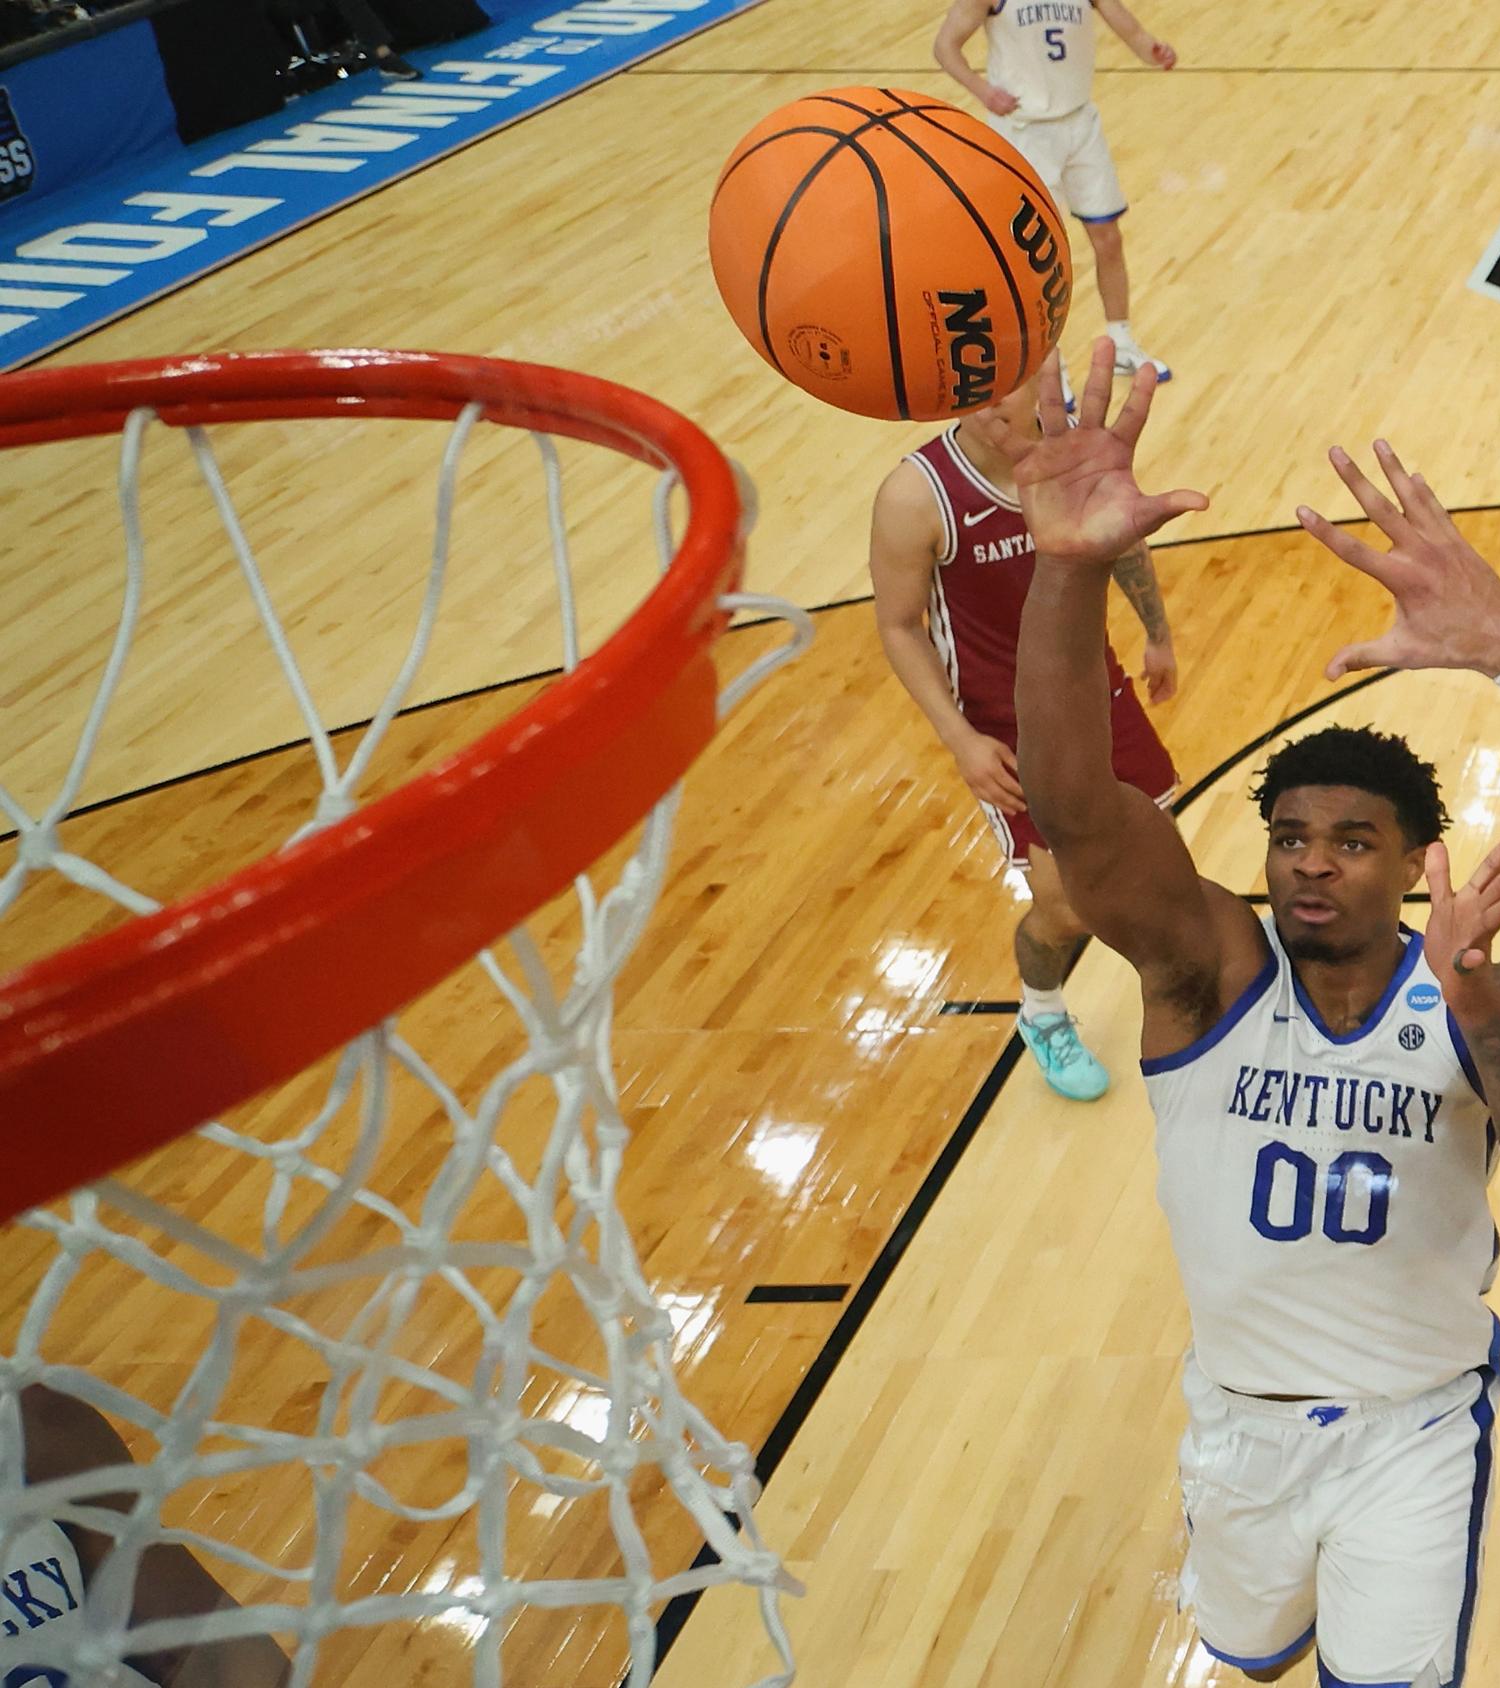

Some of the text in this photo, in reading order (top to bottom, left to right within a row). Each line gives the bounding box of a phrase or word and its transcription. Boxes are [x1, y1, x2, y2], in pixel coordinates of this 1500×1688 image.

[1017, 4, 1083, 27] KENTUCKY
[1045, 28, 1067, 61] 5
[0, 61, 566, 337] FINAL FOU
[937, 288, 997, 411] NCAA
[973, 532, 1036, 564] SANTA
[1400, 1025, 1423, 1049] SEC
[1229, 1065, 1443, 1143] KENTUCKY
[1249, 1140, 1393, 1246] 00
